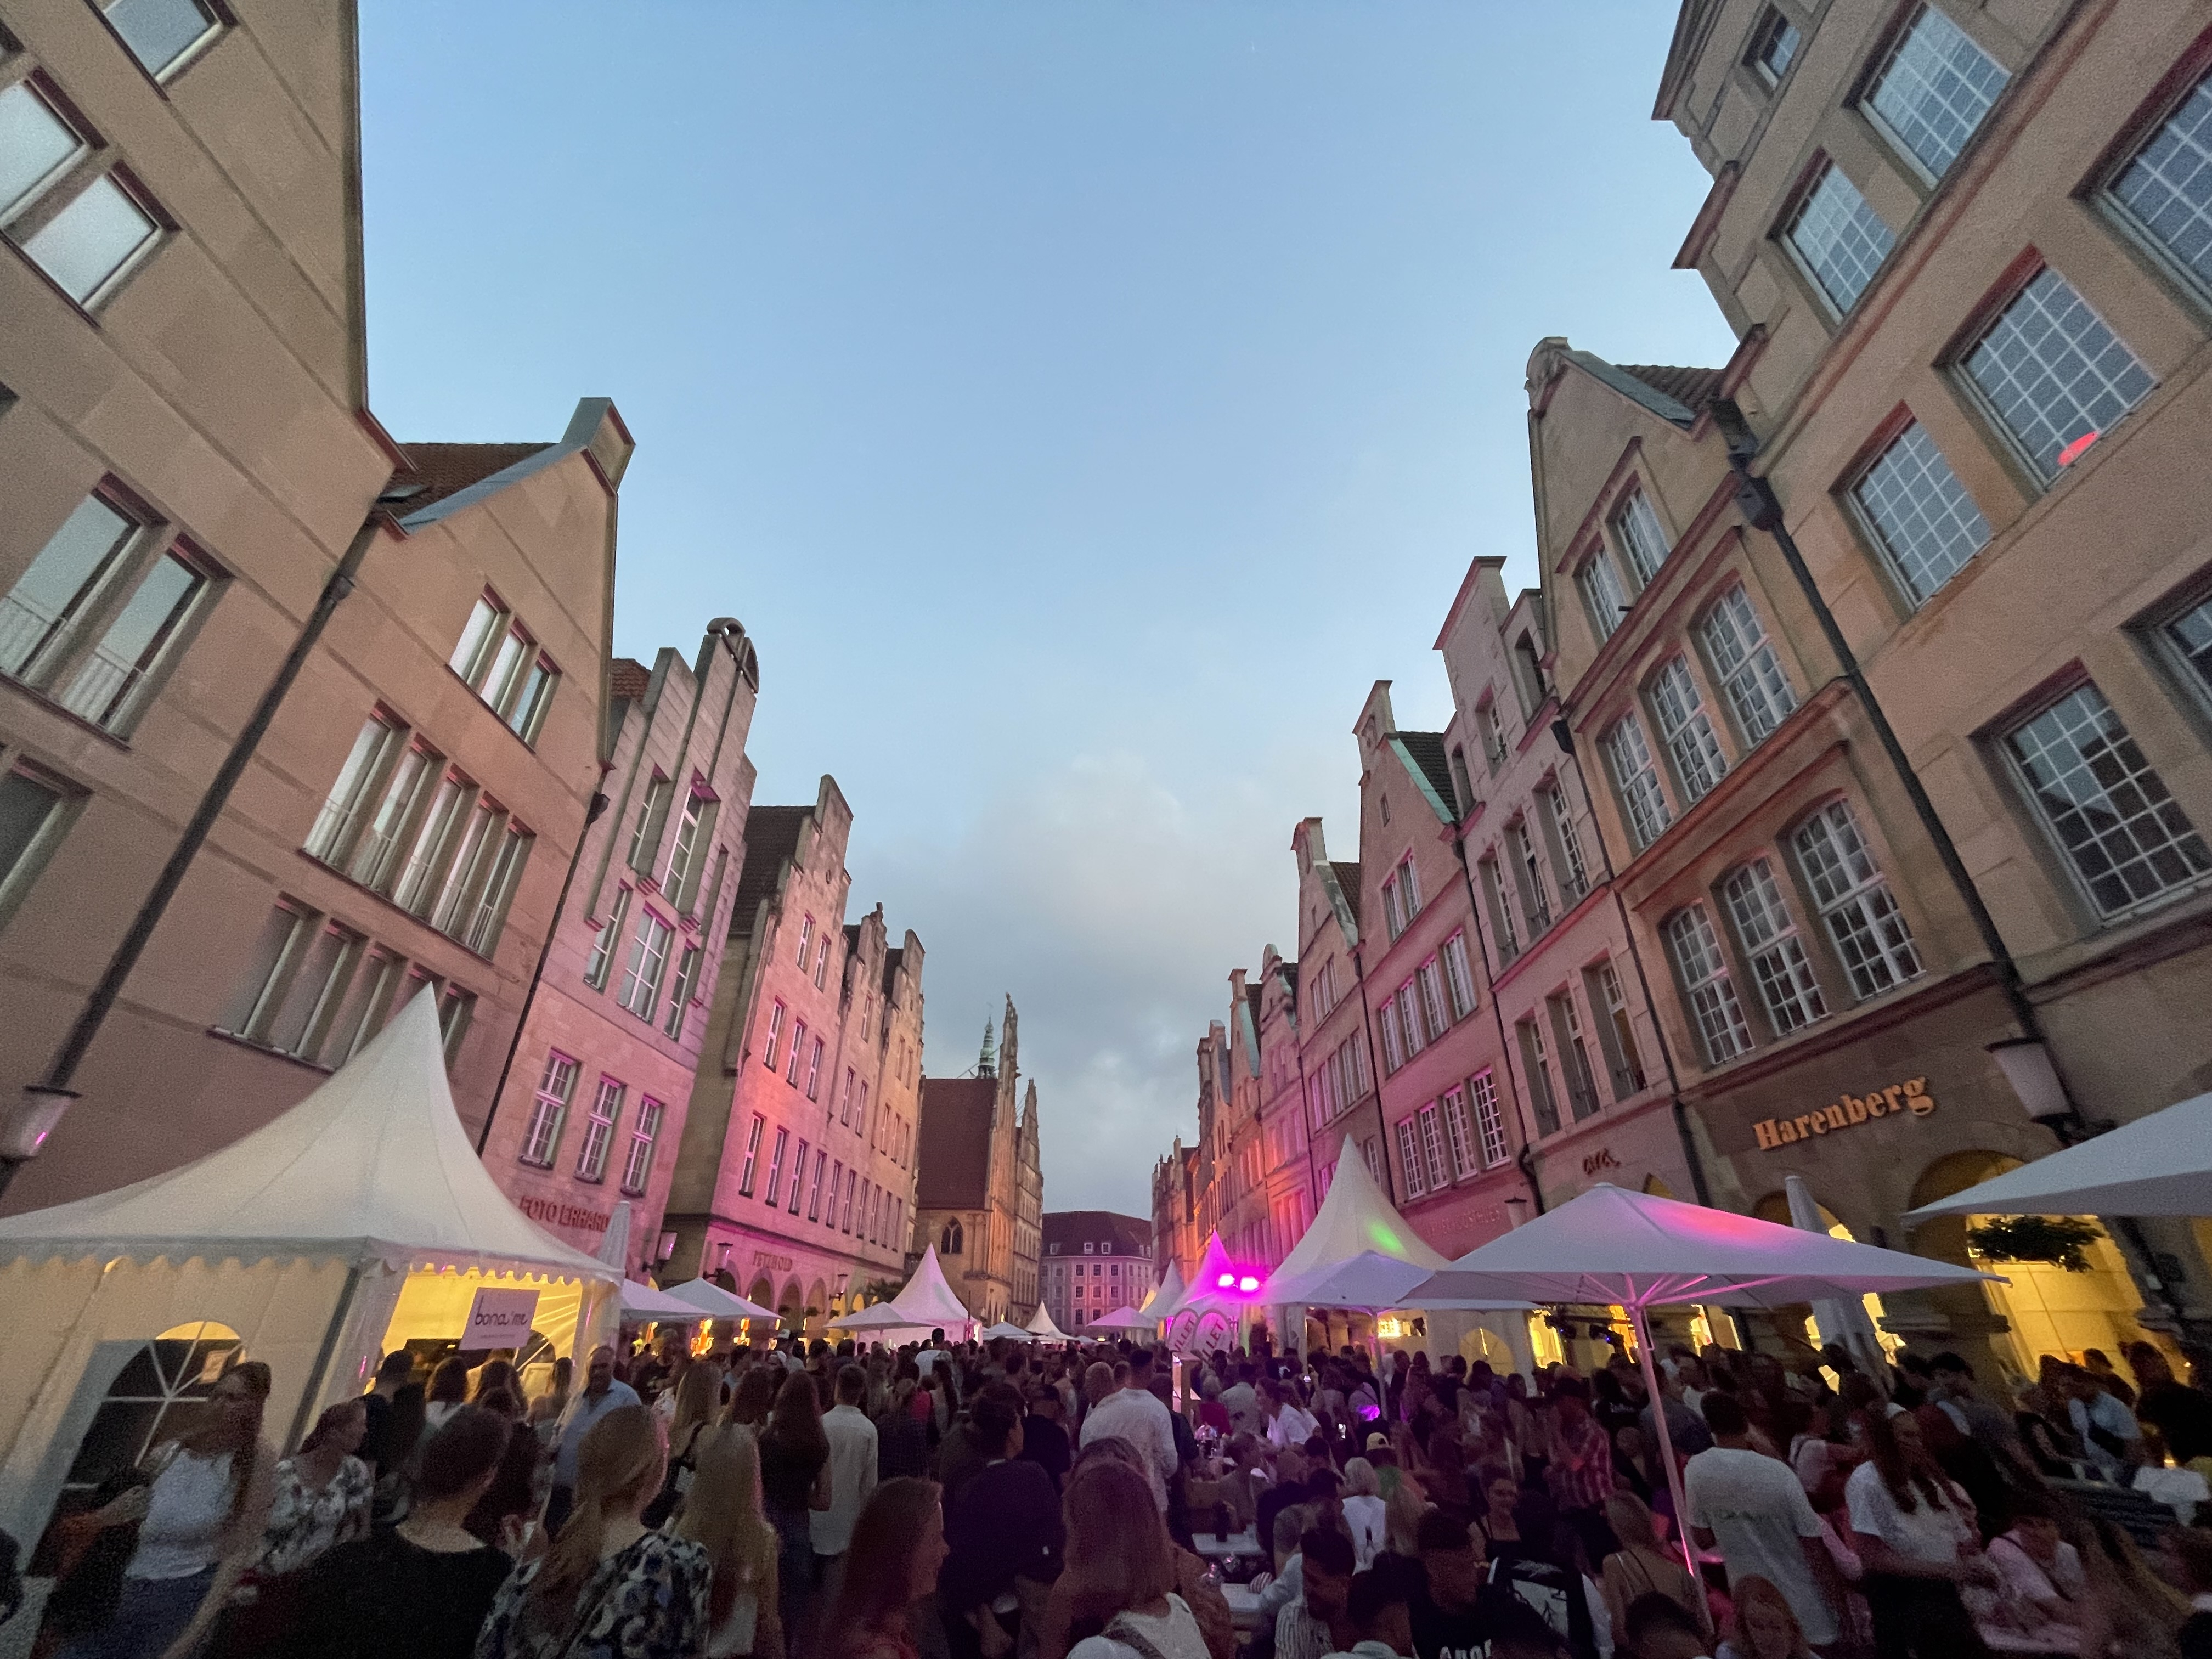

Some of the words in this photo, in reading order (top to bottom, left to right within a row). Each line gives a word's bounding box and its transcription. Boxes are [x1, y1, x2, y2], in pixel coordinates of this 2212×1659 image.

[1752, 1076, 1934, 1150] Harenberg
[520, 1195, 557, 1223] FOTO
[558, 1205, 611, 1232] ERHARD
